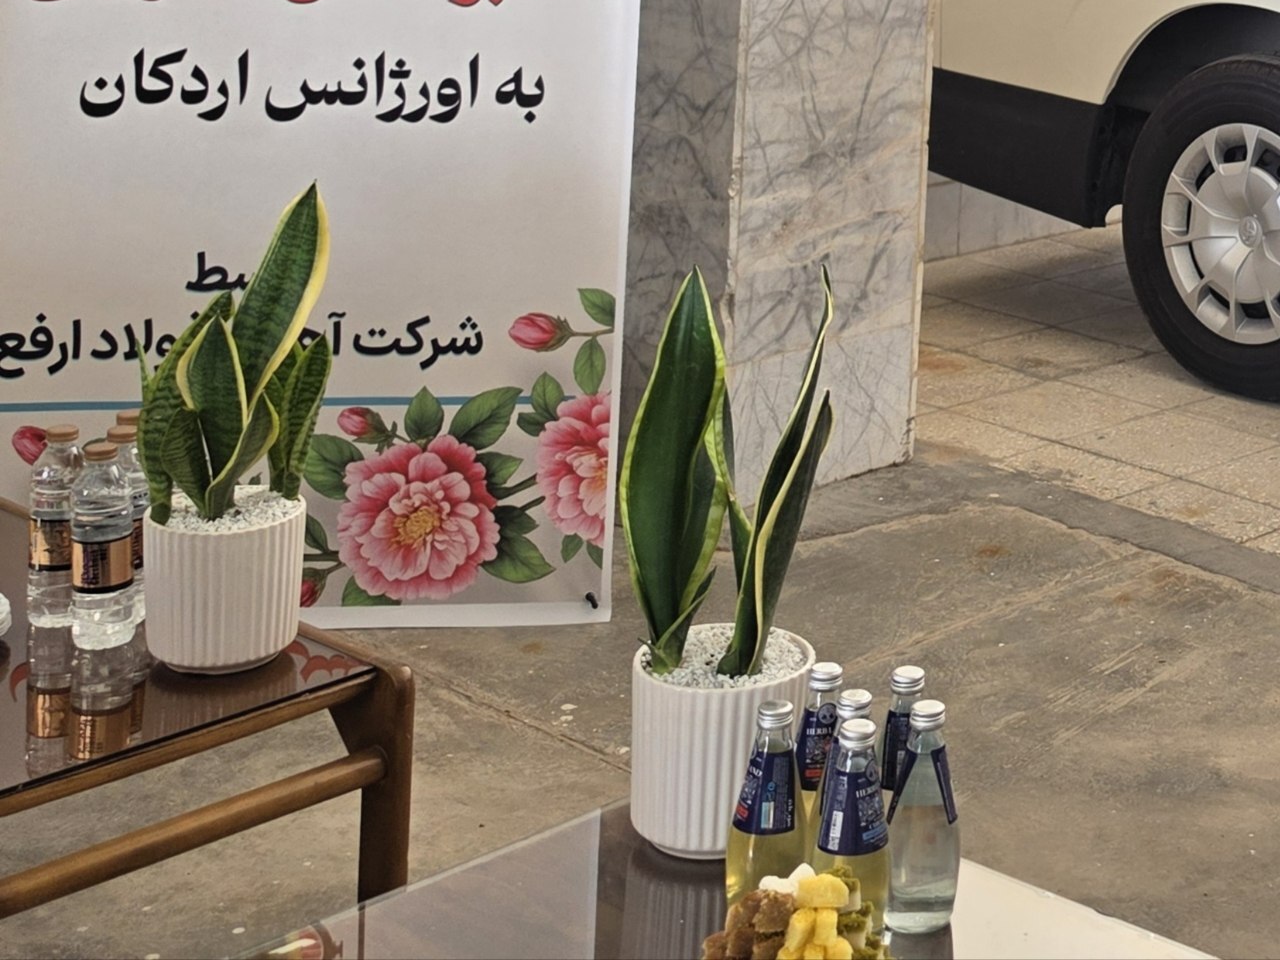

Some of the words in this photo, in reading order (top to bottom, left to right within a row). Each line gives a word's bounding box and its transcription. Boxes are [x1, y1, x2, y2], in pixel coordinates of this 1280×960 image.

[79, 47, 249, 122] اردکان
[264, 50, 480, 123] اورژانس
[493, 59, 547, 124] به
[352, 314, 484, 370] شرکت
